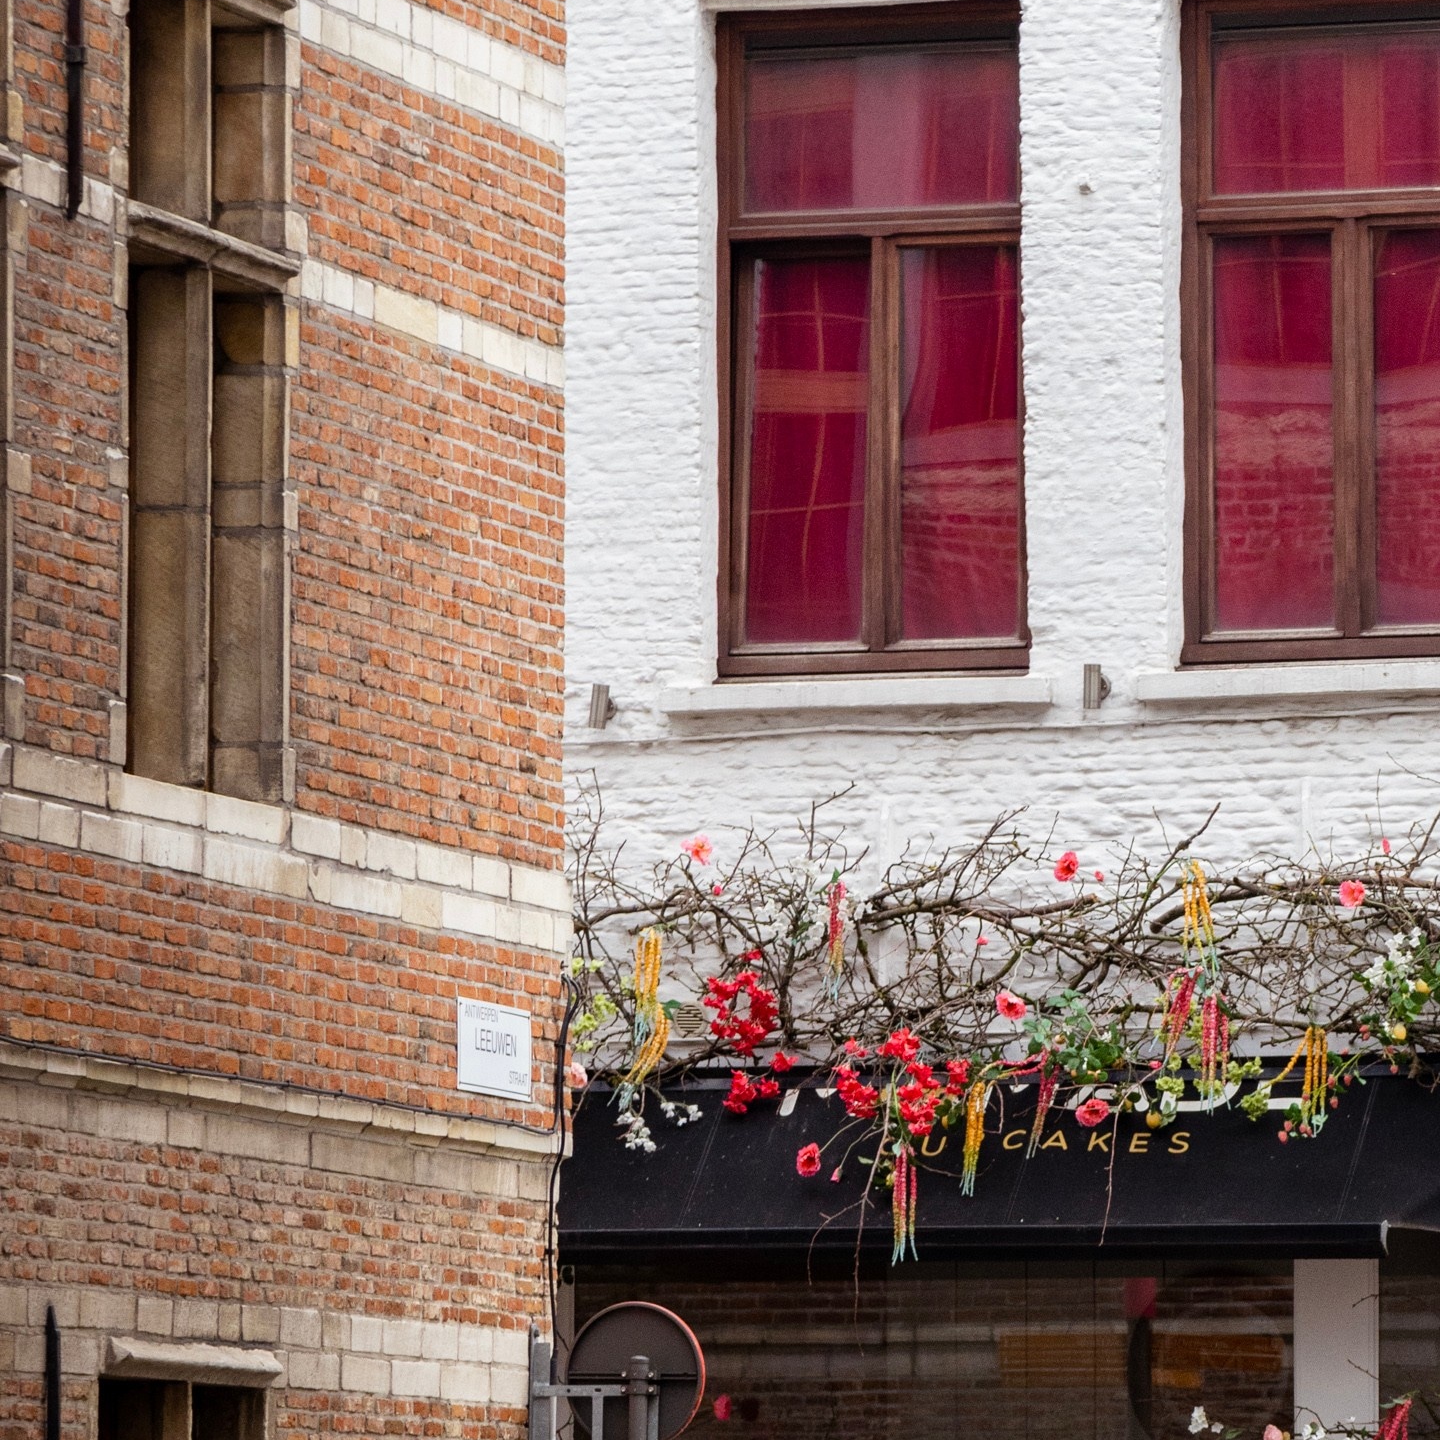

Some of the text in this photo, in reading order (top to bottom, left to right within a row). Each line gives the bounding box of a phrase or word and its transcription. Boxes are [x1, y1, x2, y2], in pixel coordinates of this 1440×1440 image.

[465, 1004, 498, 1022] ANTWERPEN
[475, 1028, 517, 1057] LEEUWEN
[509, 1070, 528, 1087] STRAAT
